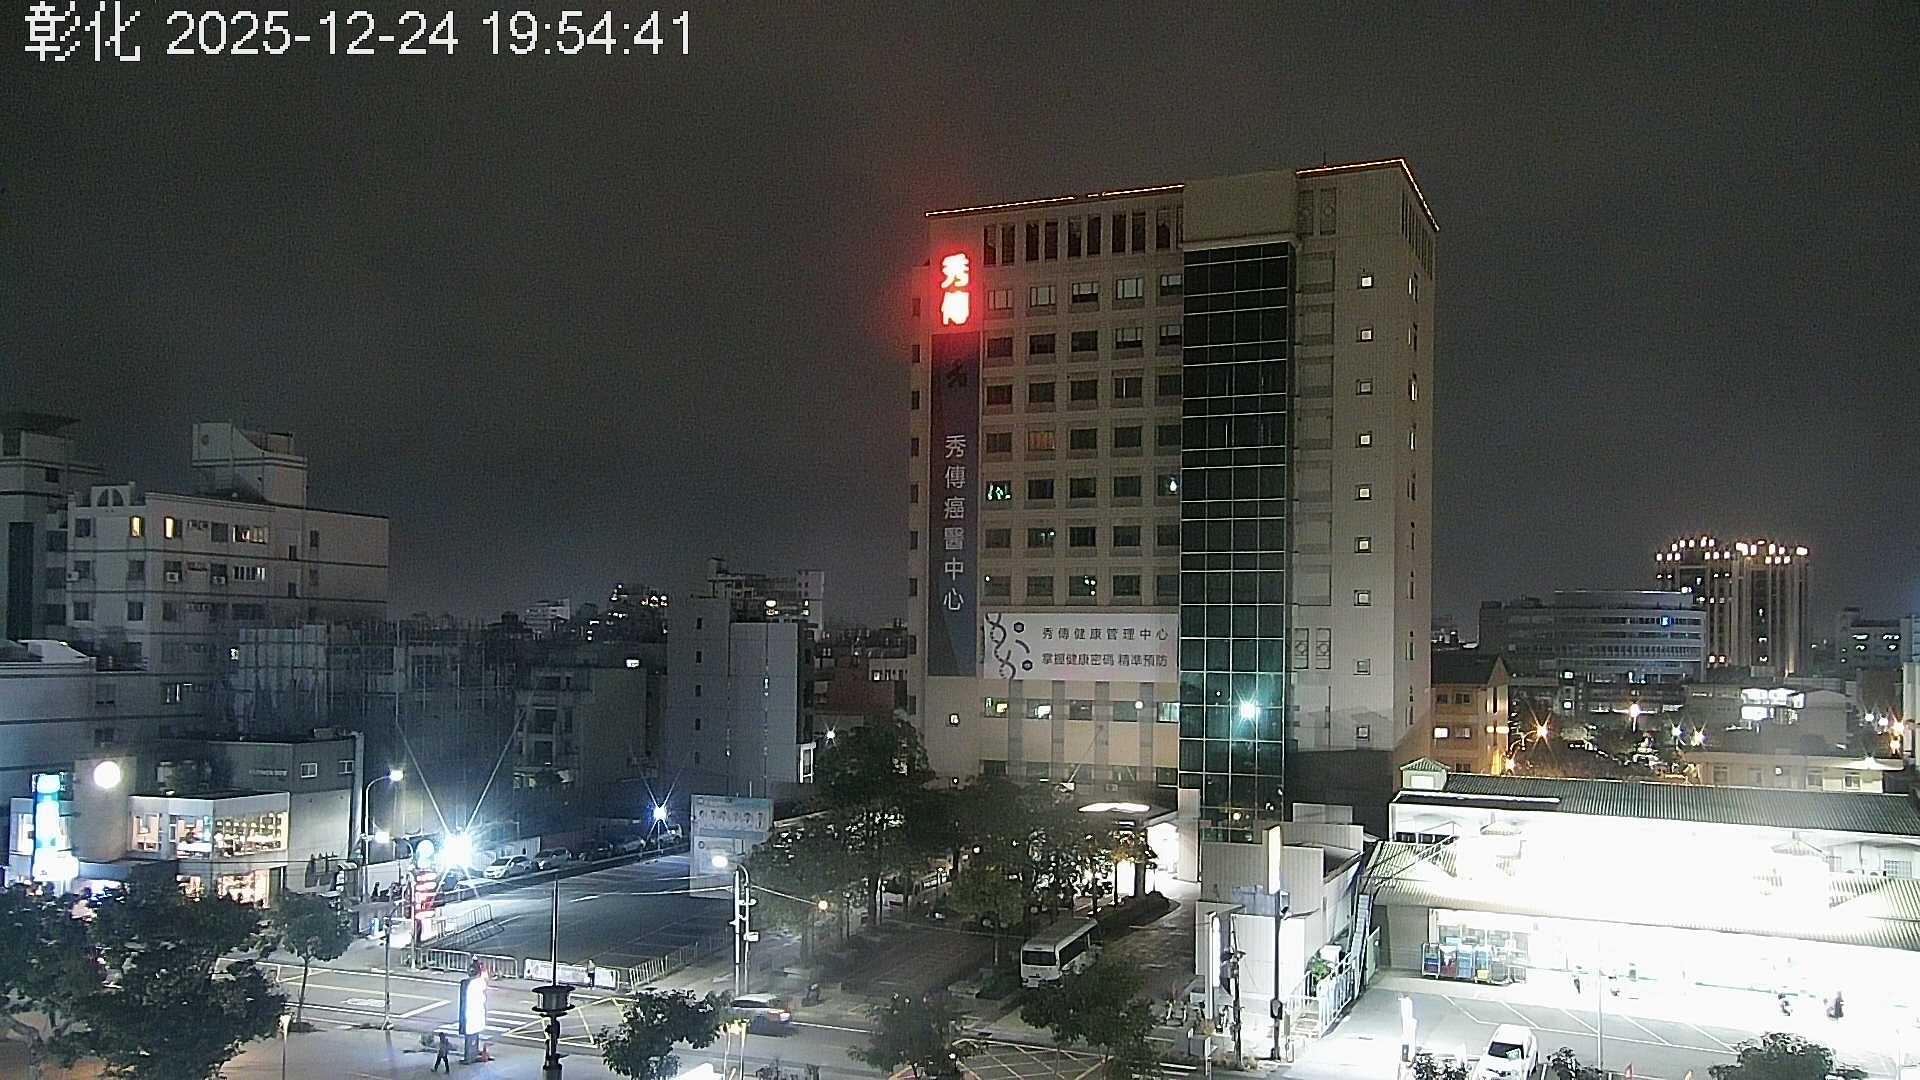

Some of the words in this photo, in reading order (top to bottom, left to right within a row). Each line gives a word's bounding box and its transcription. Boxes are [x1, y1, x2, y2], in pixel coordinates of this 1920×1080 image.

[943, 434, 967, 611] 秀傳癌醫中心
[1042, 627, 1169, 640] 秀傳健康管理中心
